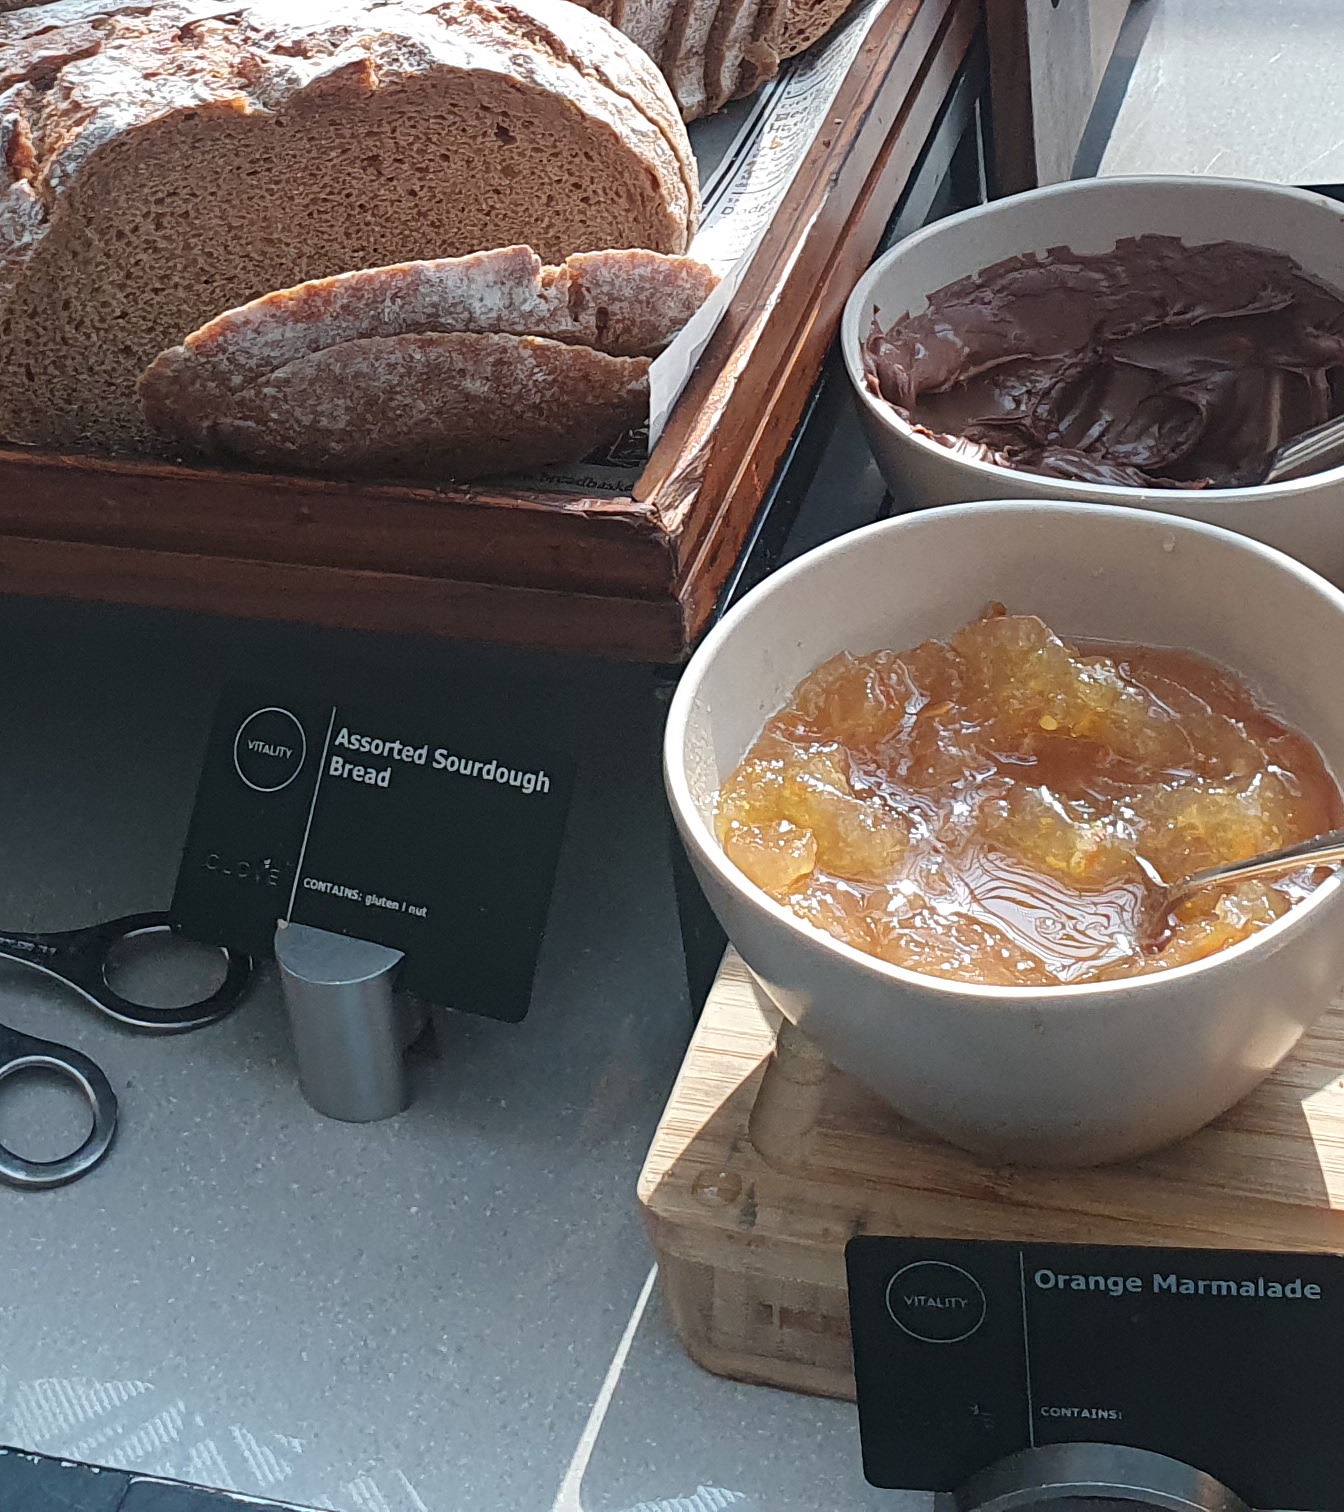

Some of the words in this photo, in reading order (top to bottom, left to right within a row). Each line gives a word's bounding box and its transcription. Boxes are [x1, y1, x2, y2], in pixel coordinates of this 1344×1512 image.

[246, 739, 294, 760] VITALITY
[335, 727, 428, 766] Assorted
[432, 748, 551, 794] Sourdough
[329, 755, 392, 789] Bread
[303, 877, 363, 901] CONTAINS:
[365, 893, 399, 910] gluten
[408, 906, 428, 918] nut
[1034, 1268, 1143, 1297] Orange
[1151, 1273, 1323, 1301] Marmalade
[903, 1294, 969, 1310] VITALITY
[1039, 1405, 1124, 1421] CONTAINS:
